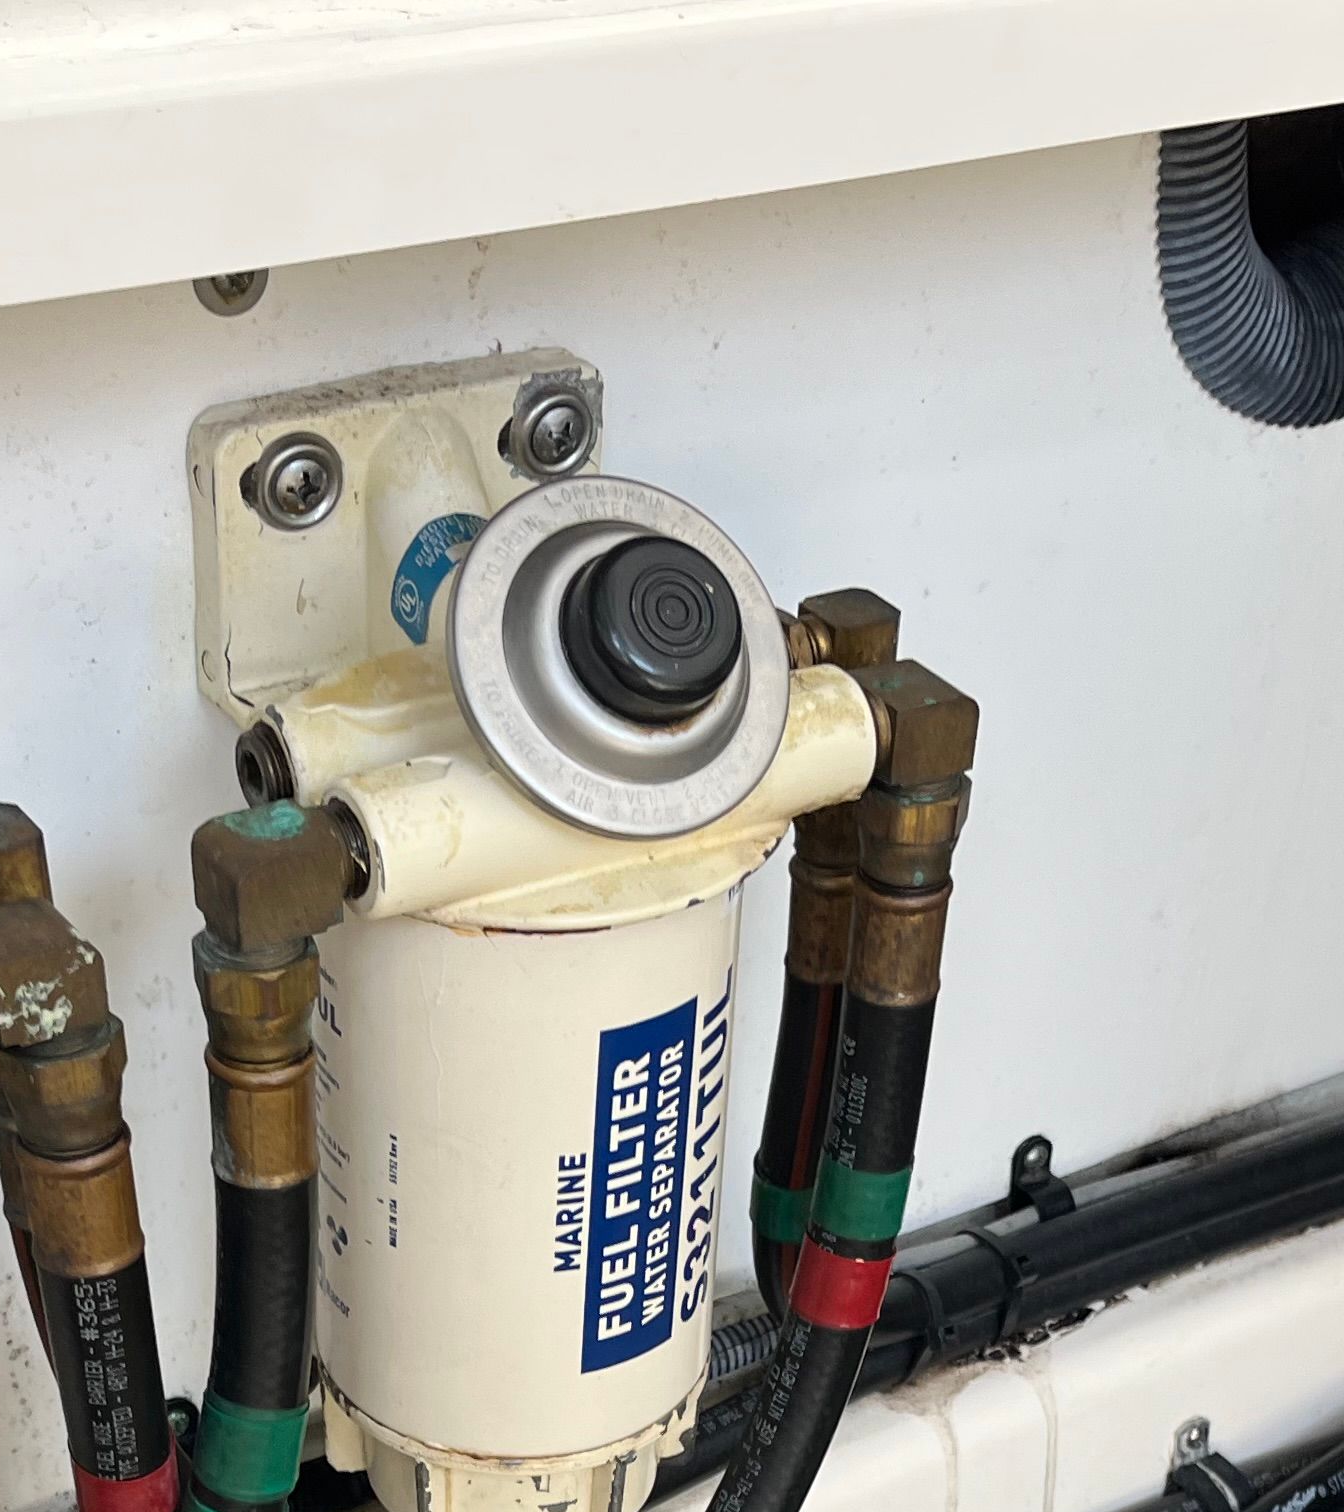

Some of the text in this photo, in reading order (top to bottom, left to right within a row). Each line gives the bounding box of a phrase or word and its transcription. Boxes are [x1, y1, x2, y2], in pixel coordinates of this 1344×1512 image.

[561, 486, 666, 509] OPEN DRAIN
[573, 503, 634, 520] WATER
[480, 563, 501, 589] TO
[565, 794, 596, 816] AIR
[680, 963, 733, 1324] S3211TUL
[597, 1051, 651, 1342] FUEL FILTER
[640, 1038, 685, 1327] WATER SEPARATOR
[389, 1199, 398, 1215] USA
[553, 1152, 587, 1273] MARINE
[389, 1228, 398, 1248] MADE
[97, 1278, 117, 1312] H-33
[104, 1330, 125, 1361] H-24
[85, 1360, 106, 1406] BARRIER
[758, 1417, 778, 1446] USE
[768, 1389, 791, 1422] WITH
[781, 1357, 800, 1389] ABYC
